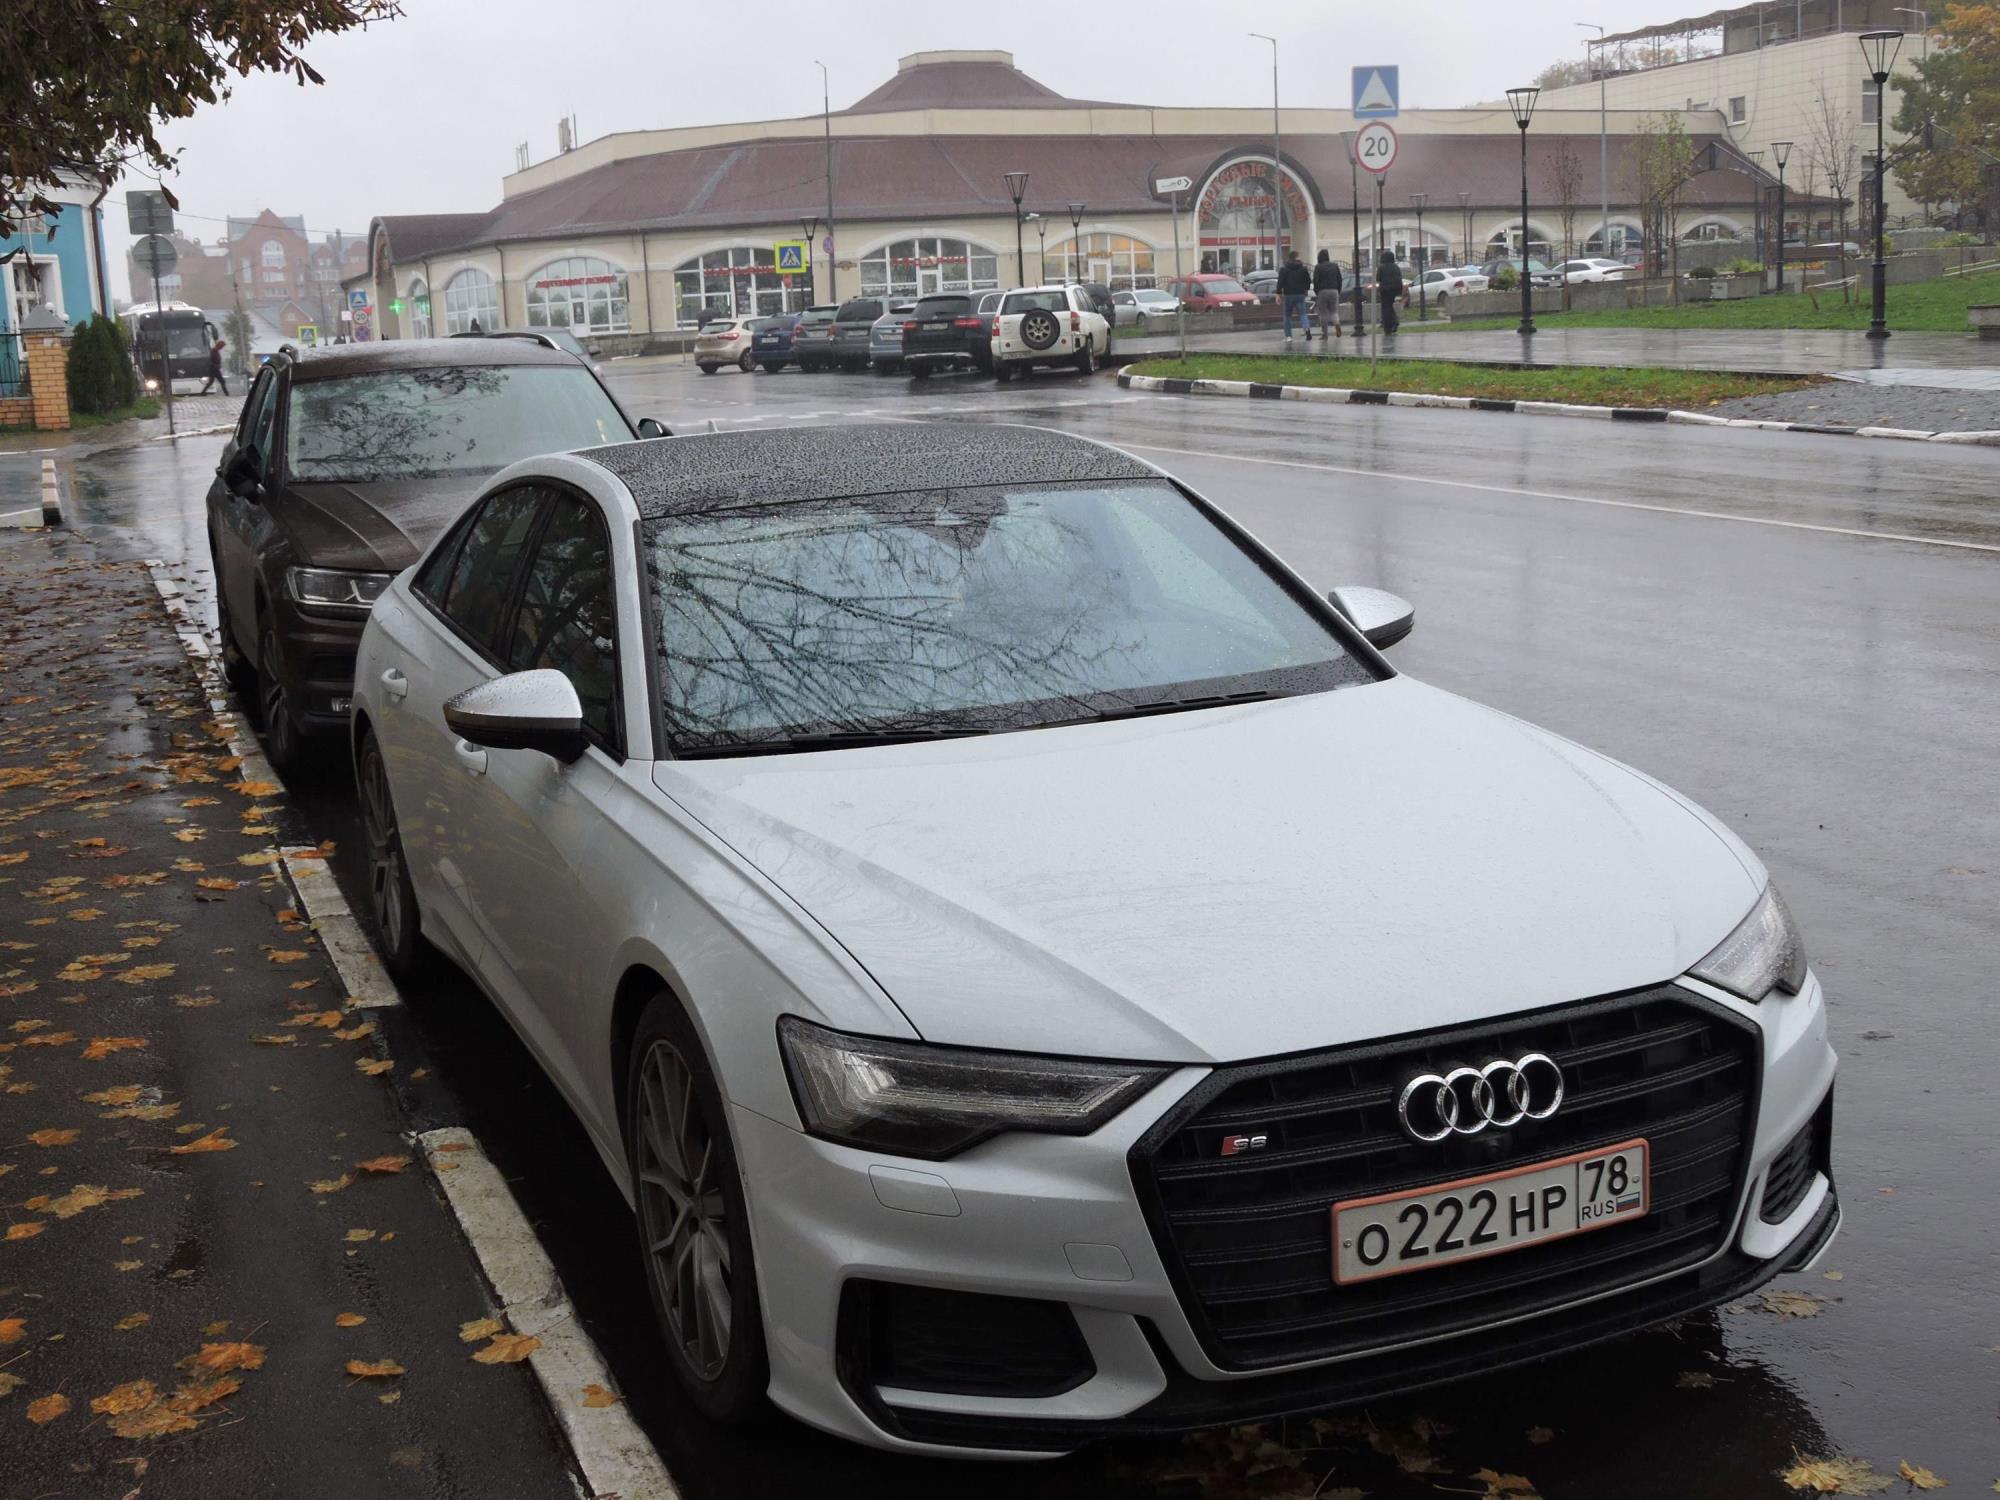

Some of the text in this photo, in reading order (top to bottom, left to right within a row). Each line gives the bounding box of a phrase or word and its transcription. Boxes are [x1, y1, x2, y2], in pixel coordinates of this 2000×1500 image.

[1364, 136, 1389, 157] 20
[1232, 1135, 1267, 1151] S6
[1584, 1154, 1629, 1203] 78
[1581, 1199, 1615, 1221] RUS
